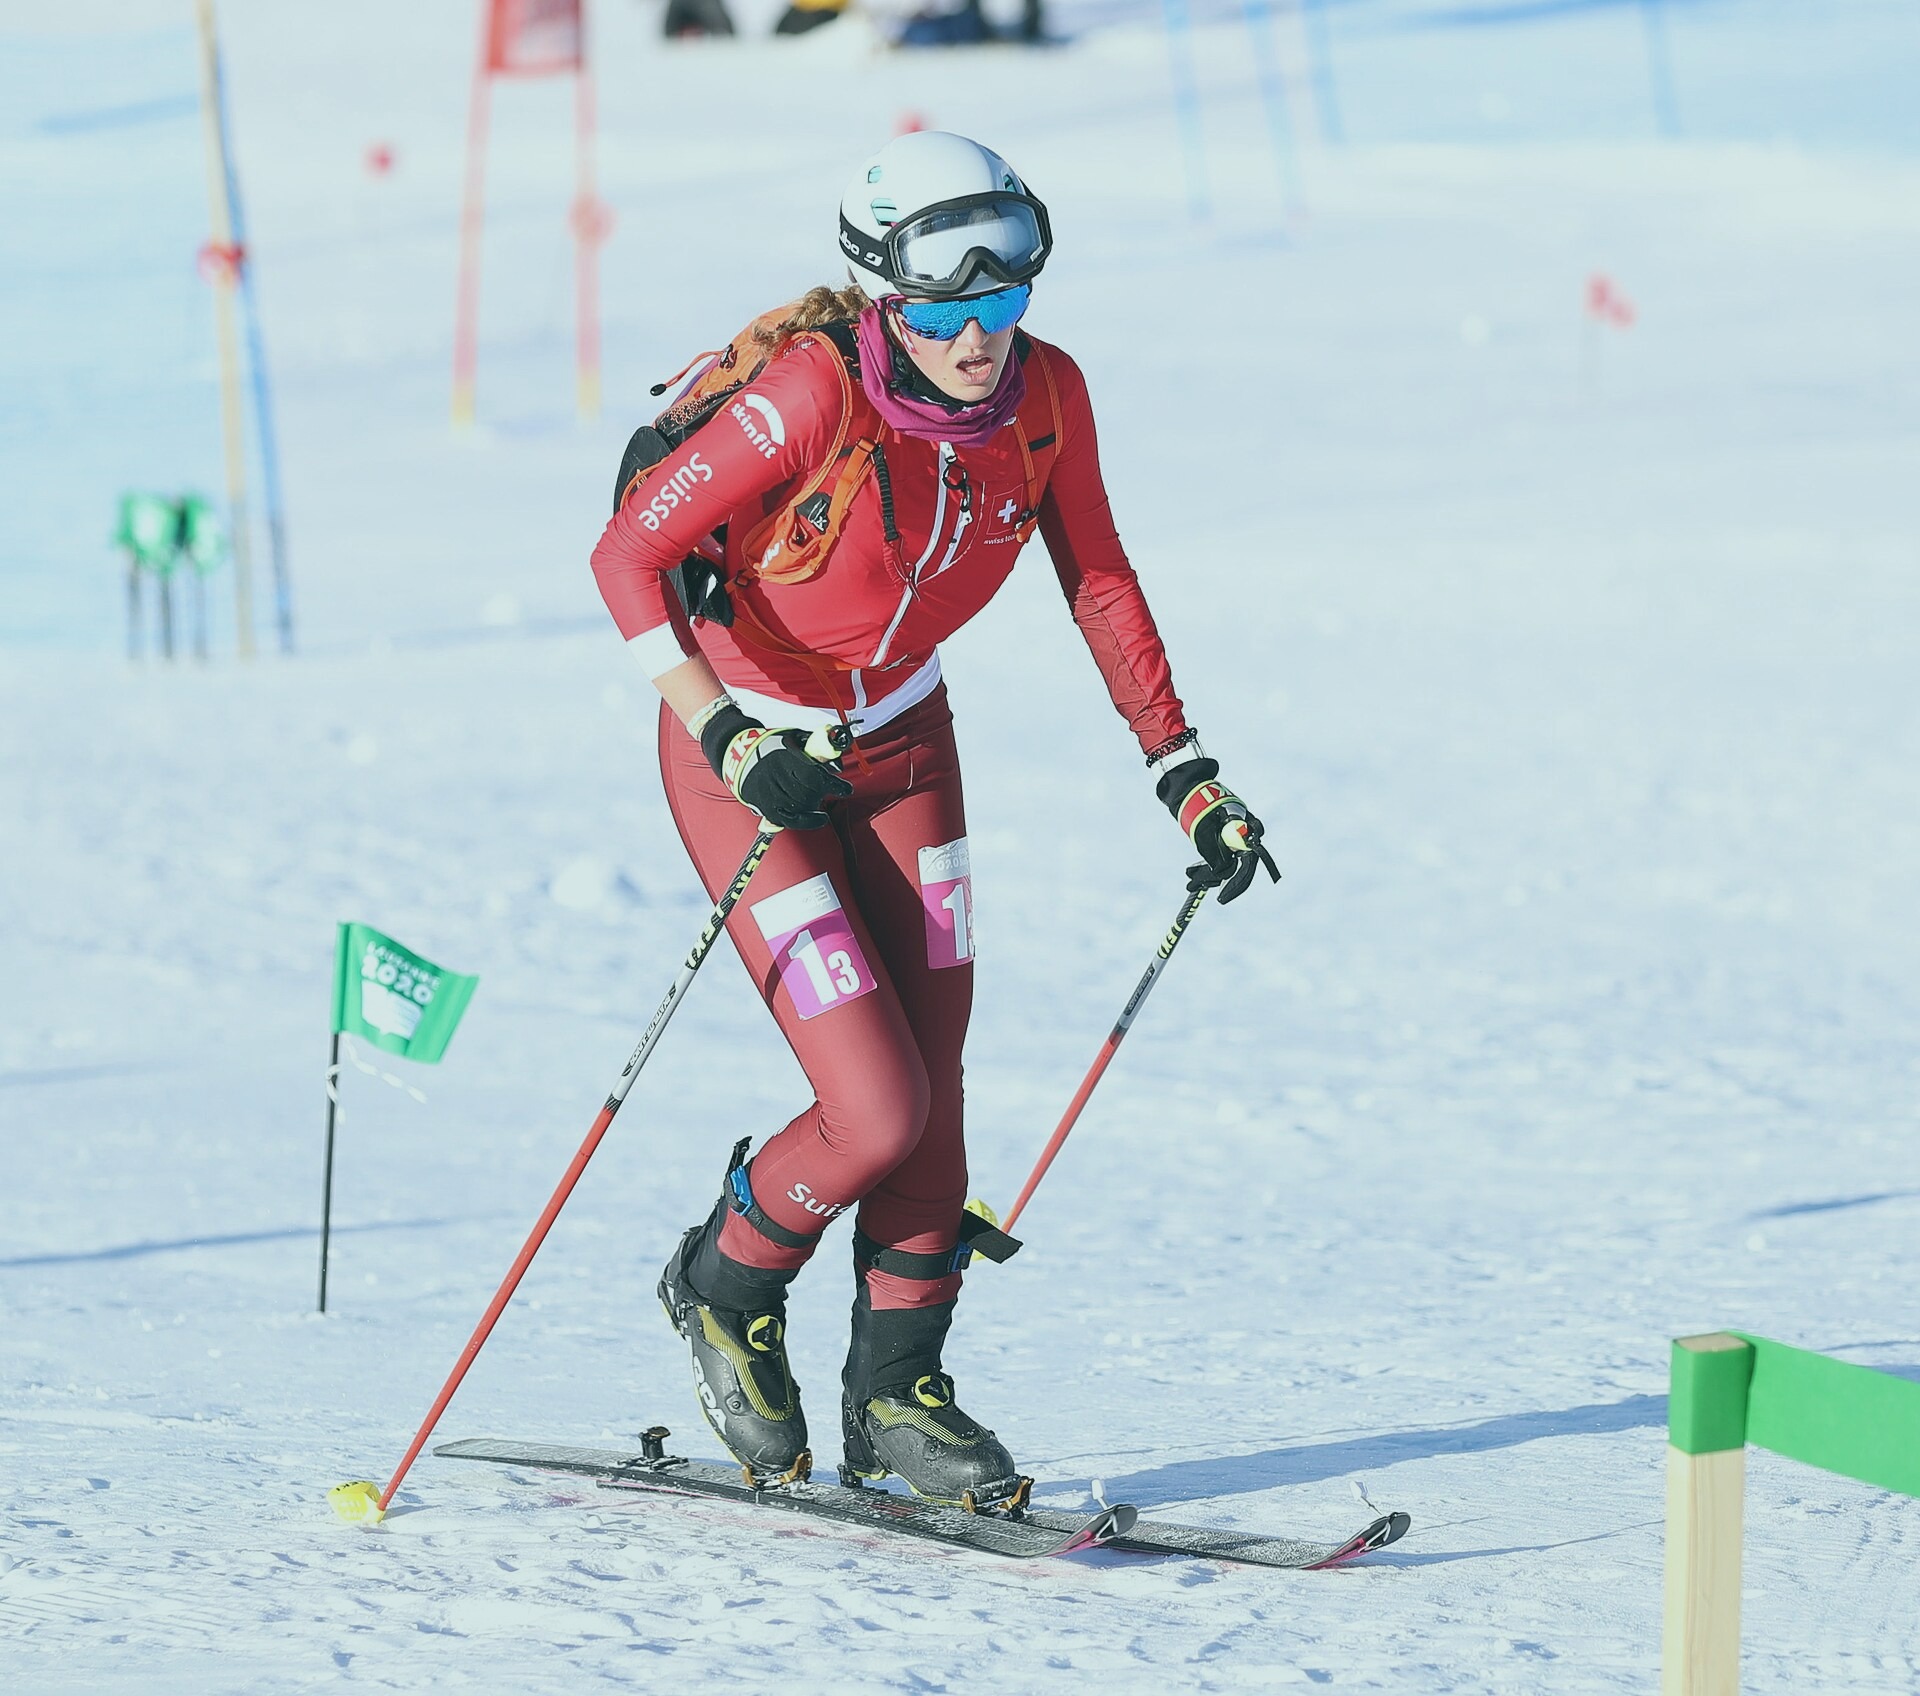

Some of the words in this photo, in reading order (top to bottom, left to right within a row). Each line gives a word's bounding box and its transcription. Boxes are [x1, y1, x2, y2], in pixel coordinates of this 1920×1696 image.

[730, 402, 778, 459] skinfit
[638, 452, 713, 532] Suisse
[788, 928, 861, 1007] 13
